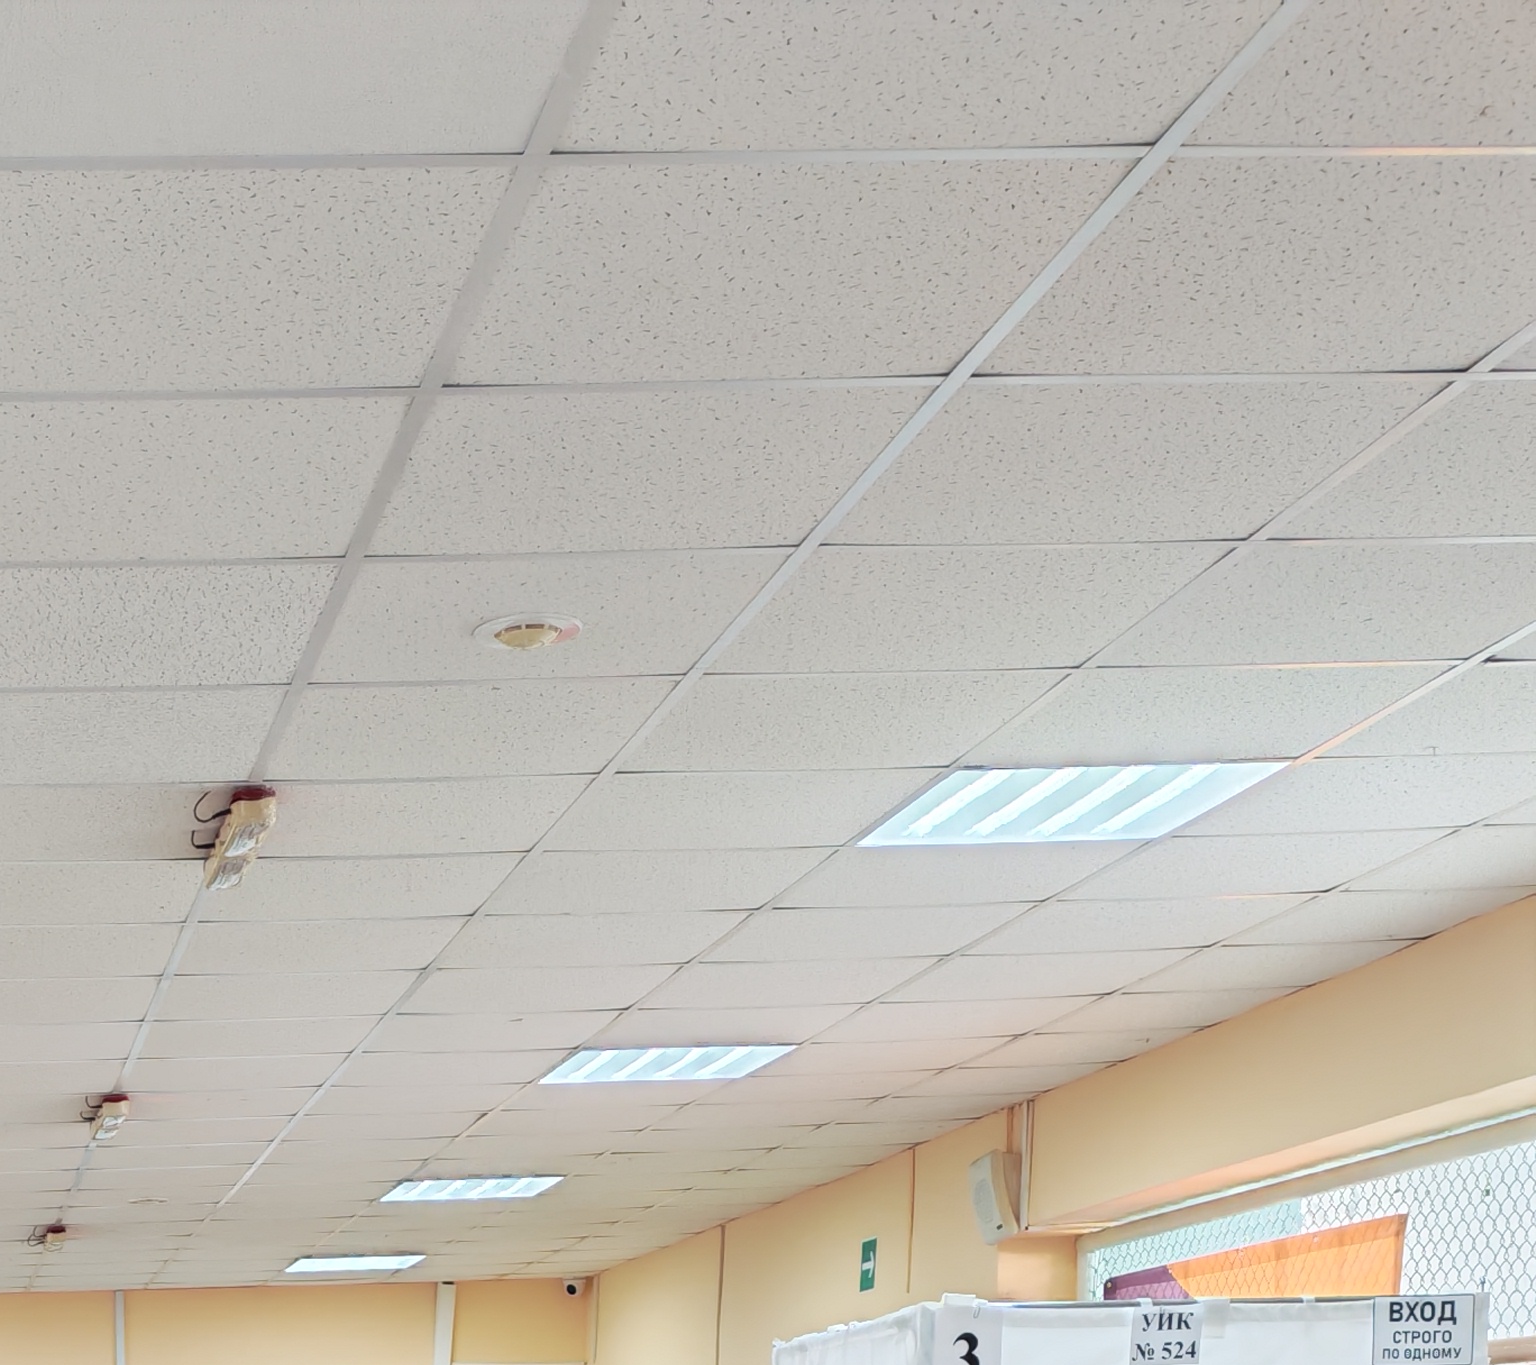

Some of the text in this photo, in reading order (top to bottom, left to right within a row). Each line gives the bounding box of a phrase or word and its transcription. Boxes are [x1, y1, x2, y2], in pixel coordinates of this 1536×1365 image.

[1142, 1311, 1194, 1332] УИК
[1389, 1300, 1457, 1325] ВХОД
[1393, 1330, 1452, 1344] СТРОГО
[1132, 1340, 1196, 1361] № 524
[1382, 1347, 1462, 1360] ПО ОДНОМУ
